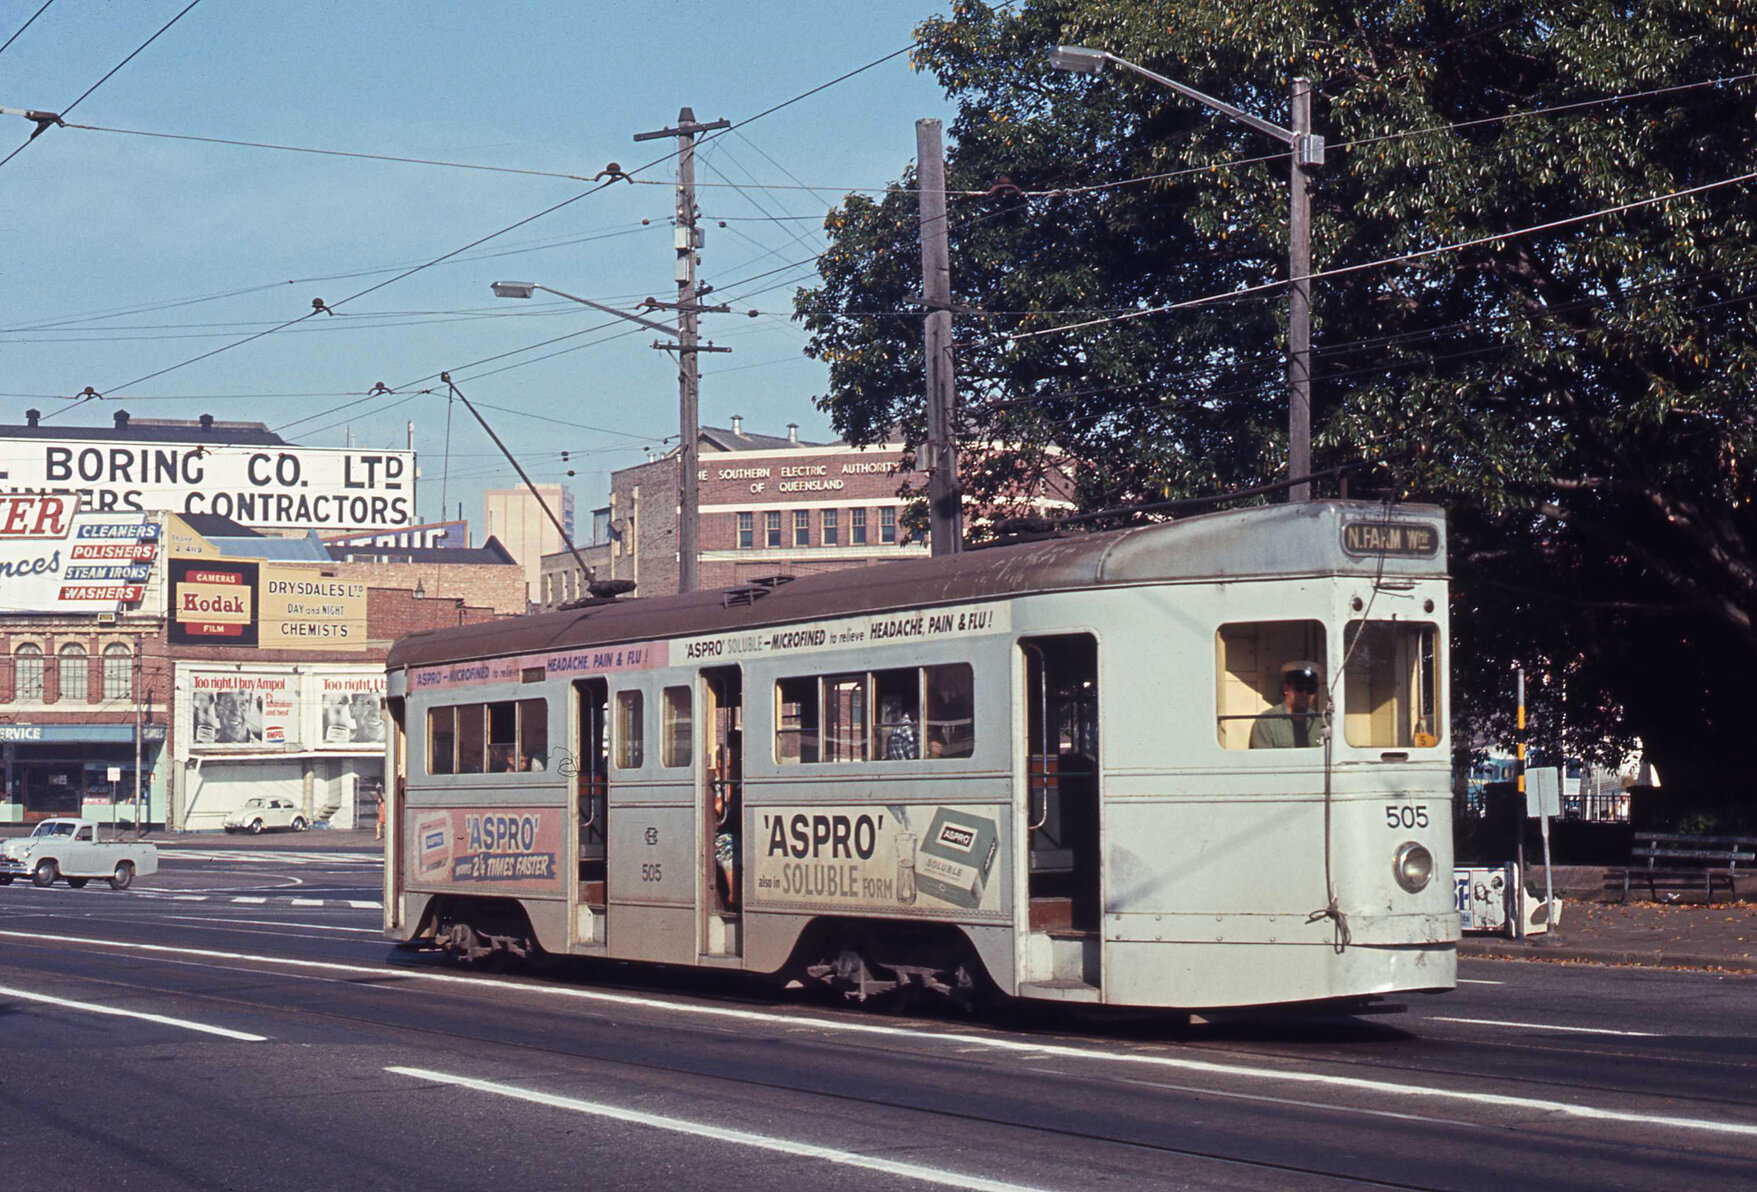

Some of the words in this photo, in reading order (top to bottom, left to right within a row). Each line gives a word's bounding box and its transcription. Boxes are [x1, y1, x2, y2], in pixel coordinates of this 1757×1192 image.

[46, 447, 204, 484] BORING
[248, 453, 308, 487] CO.
[344, 455, 404, 490] LTD
[718, 467, 770, 480] SOUTHERN
[781, 465, 827, 478] ELECTRIC
[841, 462, 901, 476] AUTHORITY
[751, 483, 765, 494] OF
[779, 480, 844, 493] QUEENSLAND
[185, 491, 408, 525] CONTRACTORS
[82, 525, 157, 538] CLEANERS
[73, 545, 152, 558] POLISHERS
[66, 566, 108, 580] STEAM
[109, 566, 147, 579] IRONS
[196, 573, 236, 584] CAMERAS
[64, 586, 135, 600] WASHERS
[269, 581, 345, 597] DRYSDALES
[183, 593, 245, 613] Kodak
[287, 605, 304, 615] DAY
[306, 605, 320, 616] and
[322, 606, 345, 616] NIGHT
[203, 625, 225, 633] FILM
[281, 622, 348, 637] CHEMISTS
[728, 635, 762, 654] SOLUBLE
[830, 632, 837, 644] to
[838, 627, 864, 643] relieve
[928, 614, 954, 634] PAIN
[958, 613, 966, 631] &
[593, 653, 613, 668] PAIN
[616, 652, 623, 666] &
[194, 676, 209, 689] Too
[234, 677, 238, 689] I
[239, 677, 256, 692] buy
[256, 677, 285, 692] Ampol
[322, 678, 342, 691] Too
[1386, 805, 1429, 829] 505
[764, 813, 884, 860] 'ASPRO'
[487, 857, 515, 877] TIMES
[516, 855, 549, 876] FASTER
[642, 863, 662, 882] 505
[926, 858, 963, 877] SOLUBLE
[758, 875, 773, 889] also
[773, 876, 780, 889] in
[783, 862, 859, 897] SOLUBLE
[862, 878, 893, 899] FORM
